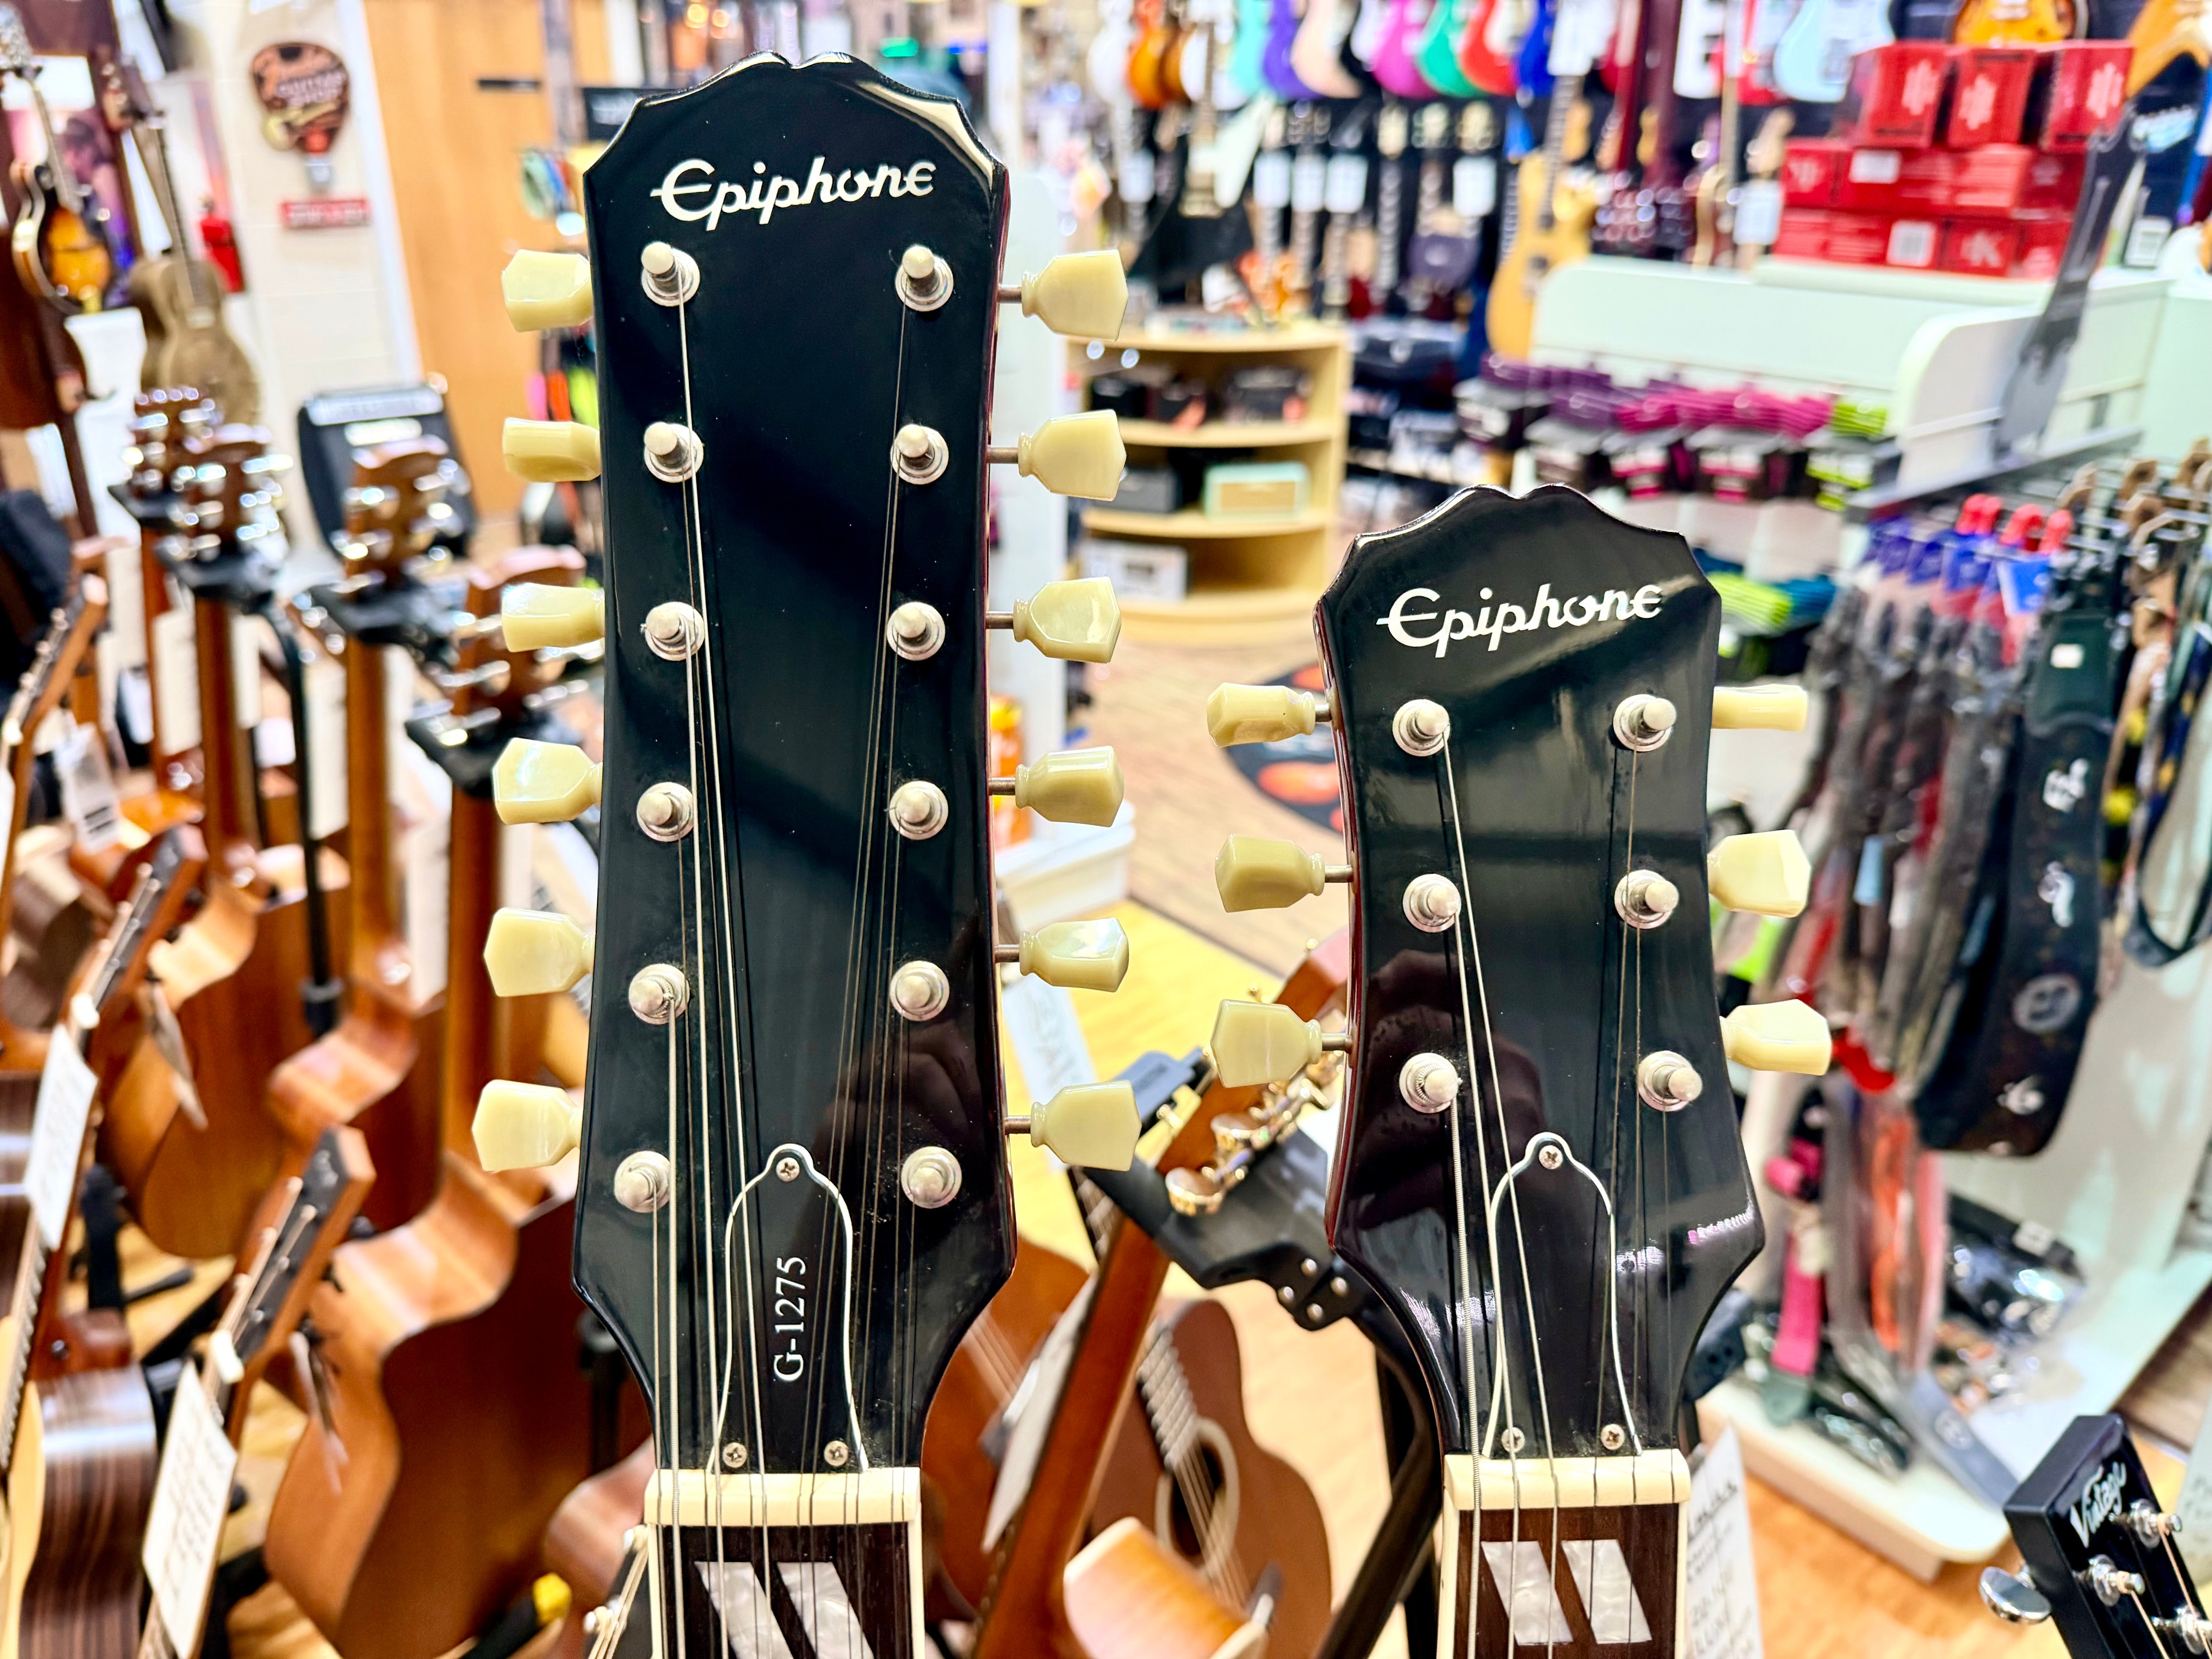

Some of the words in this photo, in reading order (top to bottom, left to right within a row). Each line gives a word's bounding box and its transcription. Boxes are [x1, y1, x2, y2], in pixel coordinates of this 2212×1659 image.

[650, 156, 936, 231] Epiphone
[1376, 584, 1662, 658] Epiphone
[774, 1257, 806, 1382] G-1275
[2069, 1461, 2127, 1548] Vintage
